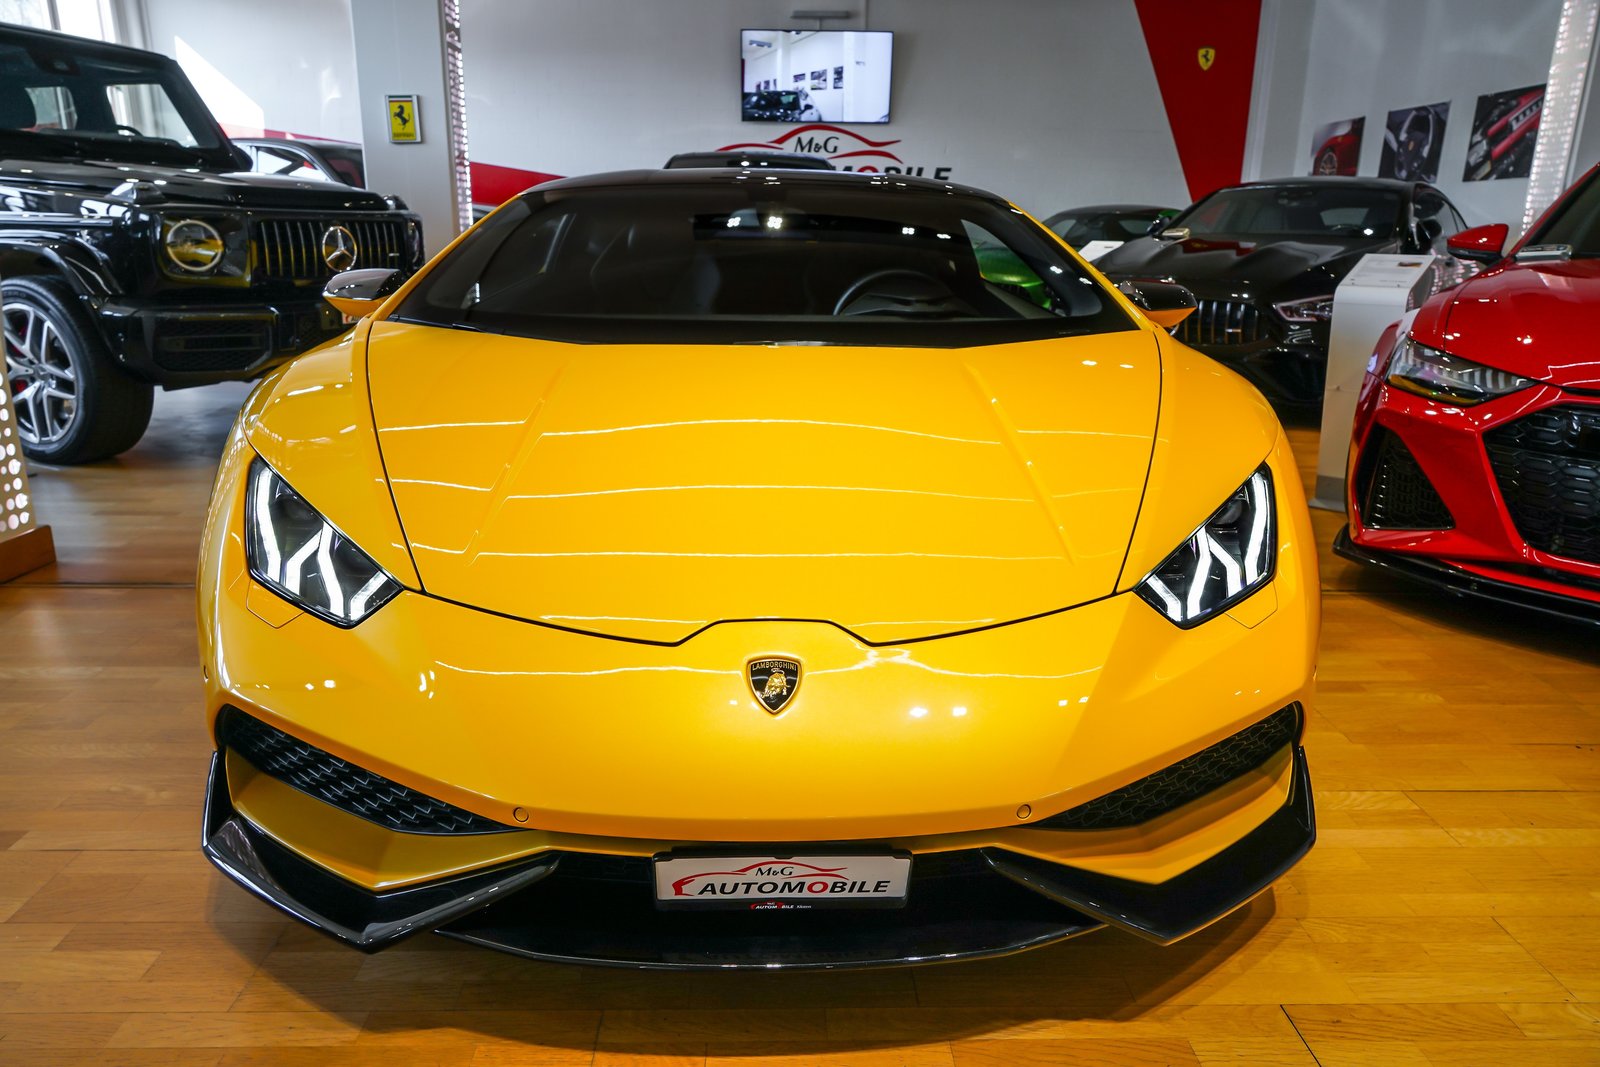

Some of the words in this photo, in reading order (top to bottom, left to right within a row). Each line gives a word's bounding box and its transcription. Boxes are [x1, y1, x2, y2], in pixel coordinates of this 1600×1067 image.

[794, 136, 840, 154] M&G
[752, 661, 797, 671] LAMBORGHINI
[755, 866, 795, 877] M&G
[698, 881, 891, 895] AUTOMOBILE
